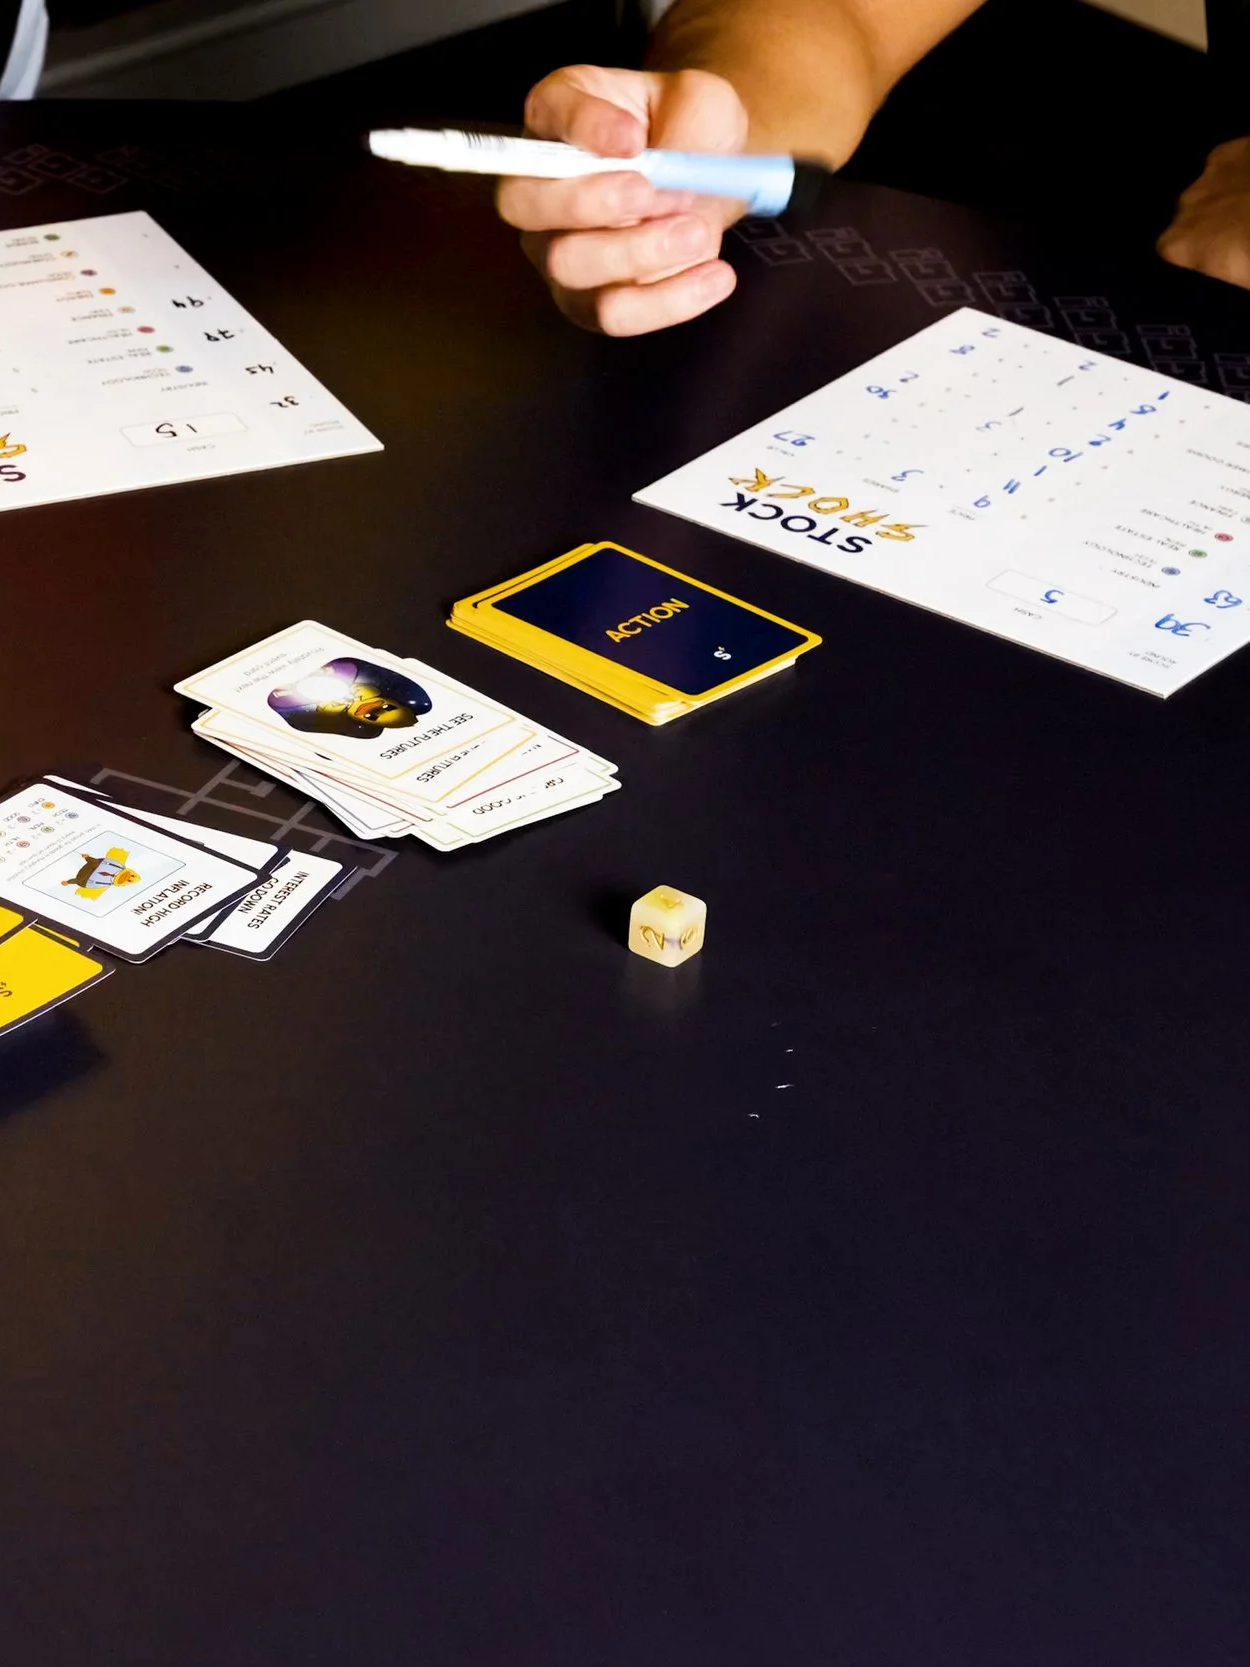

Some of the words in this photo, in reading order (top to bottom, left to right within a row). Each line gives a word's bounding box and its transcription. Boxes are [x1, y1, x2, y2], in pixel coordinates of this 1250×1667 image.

[727, 467, 929, 543] SHOCK
[716, 491, 874, 555] STOCK
[1040, 588, 1065, 605] 5
[605, 598, 690, 643] ACTION
[427, 720, 454, 741] THE
[450, 712, 474, 728] SEE
[379, 732, 432, 761] FUTURES
[132, 879, 190, 915] INFLATION!
[167, 881, 213, 911] RECORD
[237, 886, 266, 914] DOWN
[270, 870, 310, 906] INTEREST
[139, 907, 169, 928] HIGH
[246, 899, 275, 930] RATES
